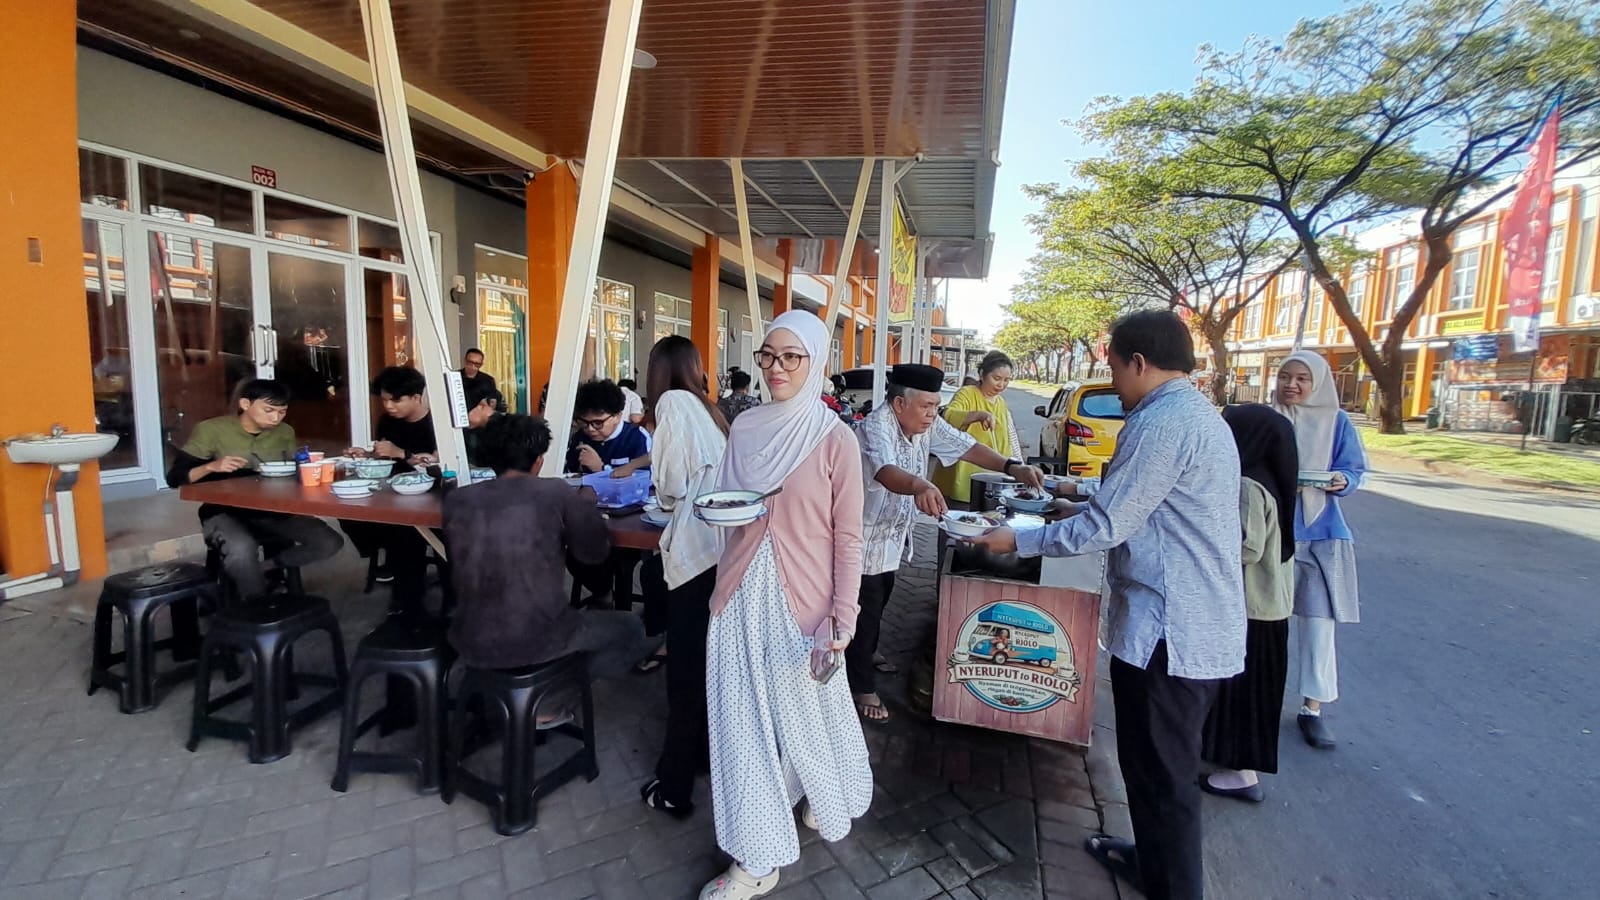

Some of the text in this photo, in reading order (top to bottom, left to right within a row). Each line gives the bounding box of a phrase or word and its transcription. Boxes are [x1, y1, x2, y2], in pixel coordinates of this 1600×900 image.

[254, 173, 274, 187] 002
[1015, 639, 1038, 647] RIOLO
[959, 666, 1019, 680] NYERUPUT
[1031, 673, 1069, 692] RIOLO
